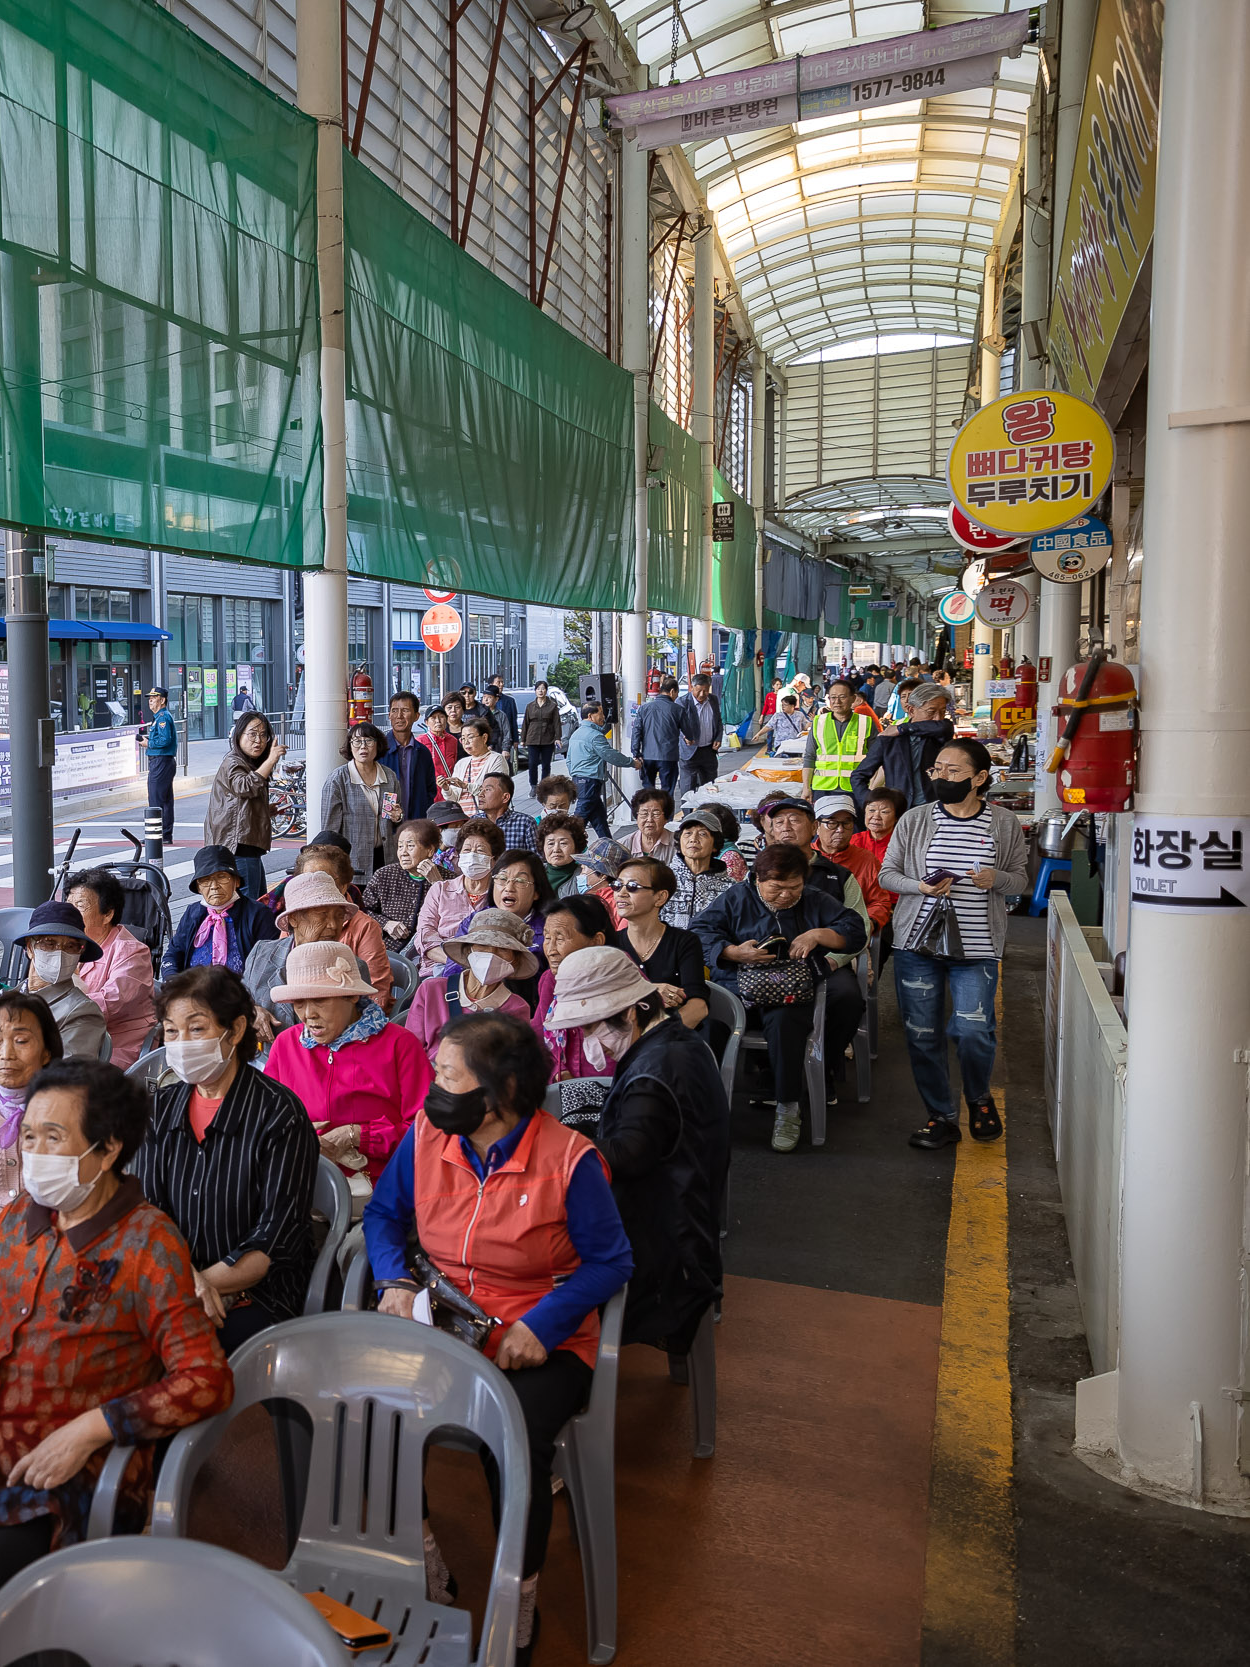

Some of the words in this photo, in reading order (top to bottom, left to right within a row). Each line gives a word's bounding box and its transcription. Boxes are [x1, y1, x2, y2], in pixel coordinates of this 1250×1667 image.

[733, 74, 778, 97] 방문해
[836, 44, 915, 76] 감사합니다
[852, 68, 945, 102] 1577-9844
[694, 97, 778, 127] 바른본병원
[1004, 398, 1054, 444] 왕
[967, 441, 1094, 477] 뼈다귀탕
[967, 472, 1092, 508] 두루치기
[1037, 531, 1107, 551] 中國食品
[1048, 567, 1096, 581] 465-0624
[990, 595, 1015, 616] 떡
[1133, 827, 1242, 871] 화장실
[1135, 877, 1178, 894] TOILET
